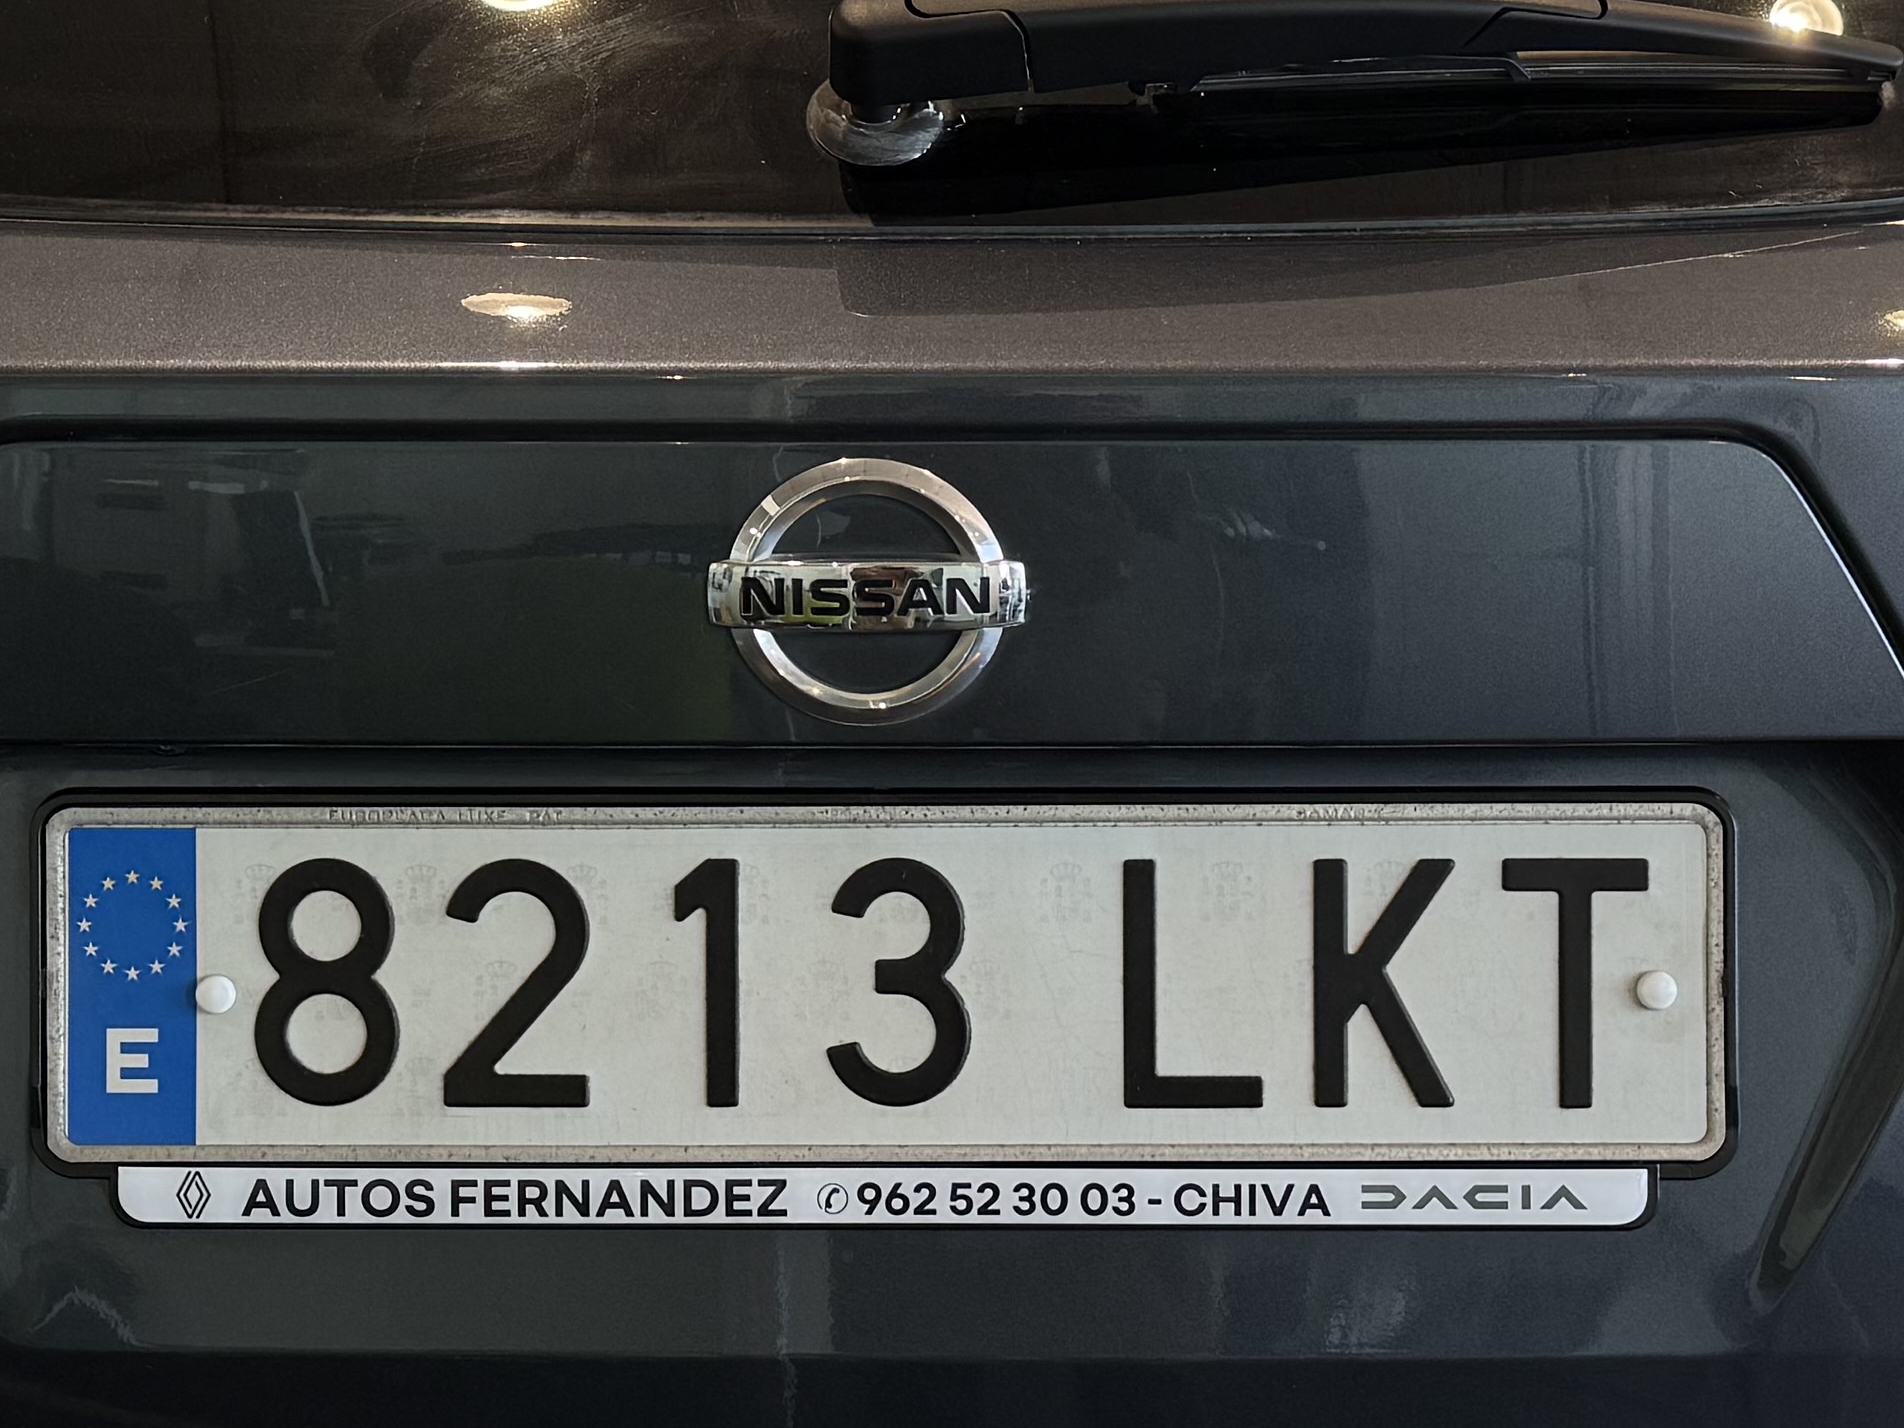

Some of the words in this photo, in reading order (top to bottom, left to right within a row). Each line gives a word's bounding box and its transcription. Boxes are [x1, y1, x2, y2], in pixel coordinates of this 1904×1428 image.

[740, 576, 990, 620] NISSAN
[254, 857, 972, 1109] 8213
[1123, 857, 1649, 1110] LKT
[106, 1028, 159, 1094] E
[241, 1178, 436, 1218] AUTOS
[450, 1178, 788, 1218] FERNANDEZ
[856, 1181, 938, 1216] 962
[949, 1181, 1001, 1217] 52
[1012, 1181, 1069, 1217] 30
[1080, 1181, 1136, 1217] 03
[1173, 1182, 1332, 1217] CHIVA
[1360, 1184, 1588, 1211] DACIA
